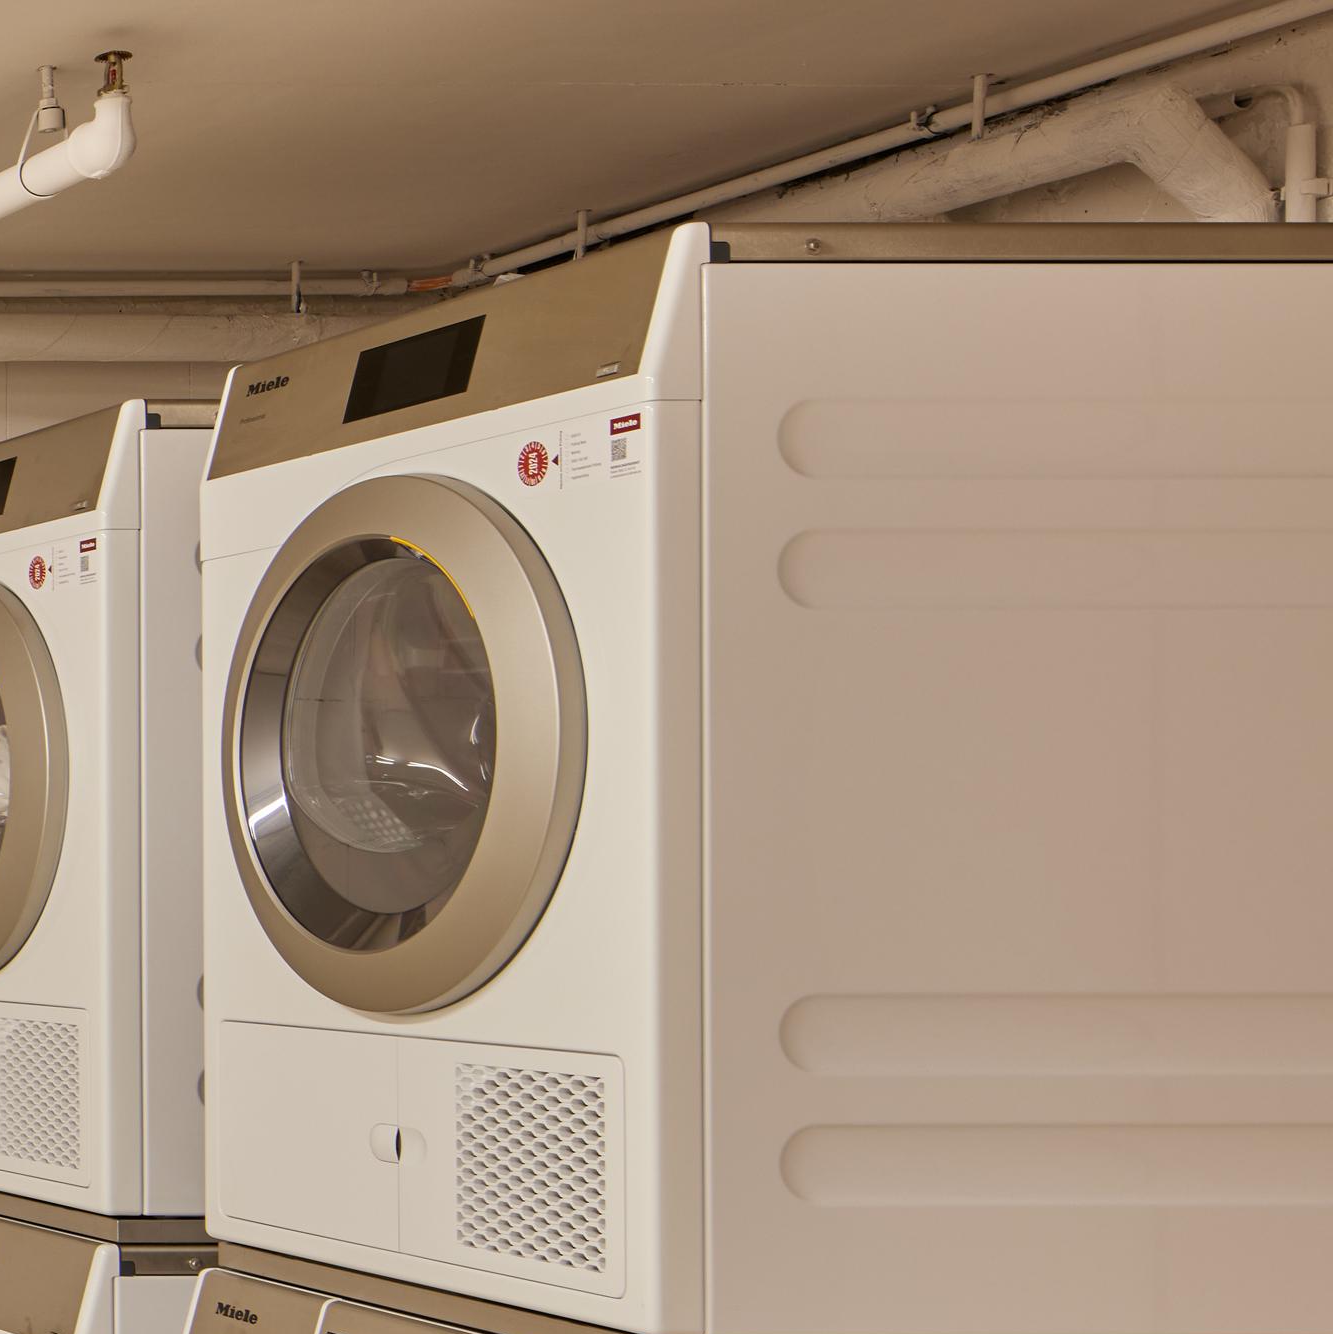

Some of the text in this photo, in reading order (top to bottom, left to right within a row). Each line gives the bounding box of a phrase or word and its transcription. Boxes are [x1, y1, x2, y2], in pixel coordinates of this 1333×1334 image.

[246, 376, 290, 397] Miele
[528, 452, 538, 475] 2024
[215, 1302, 258, 1324] Miele
